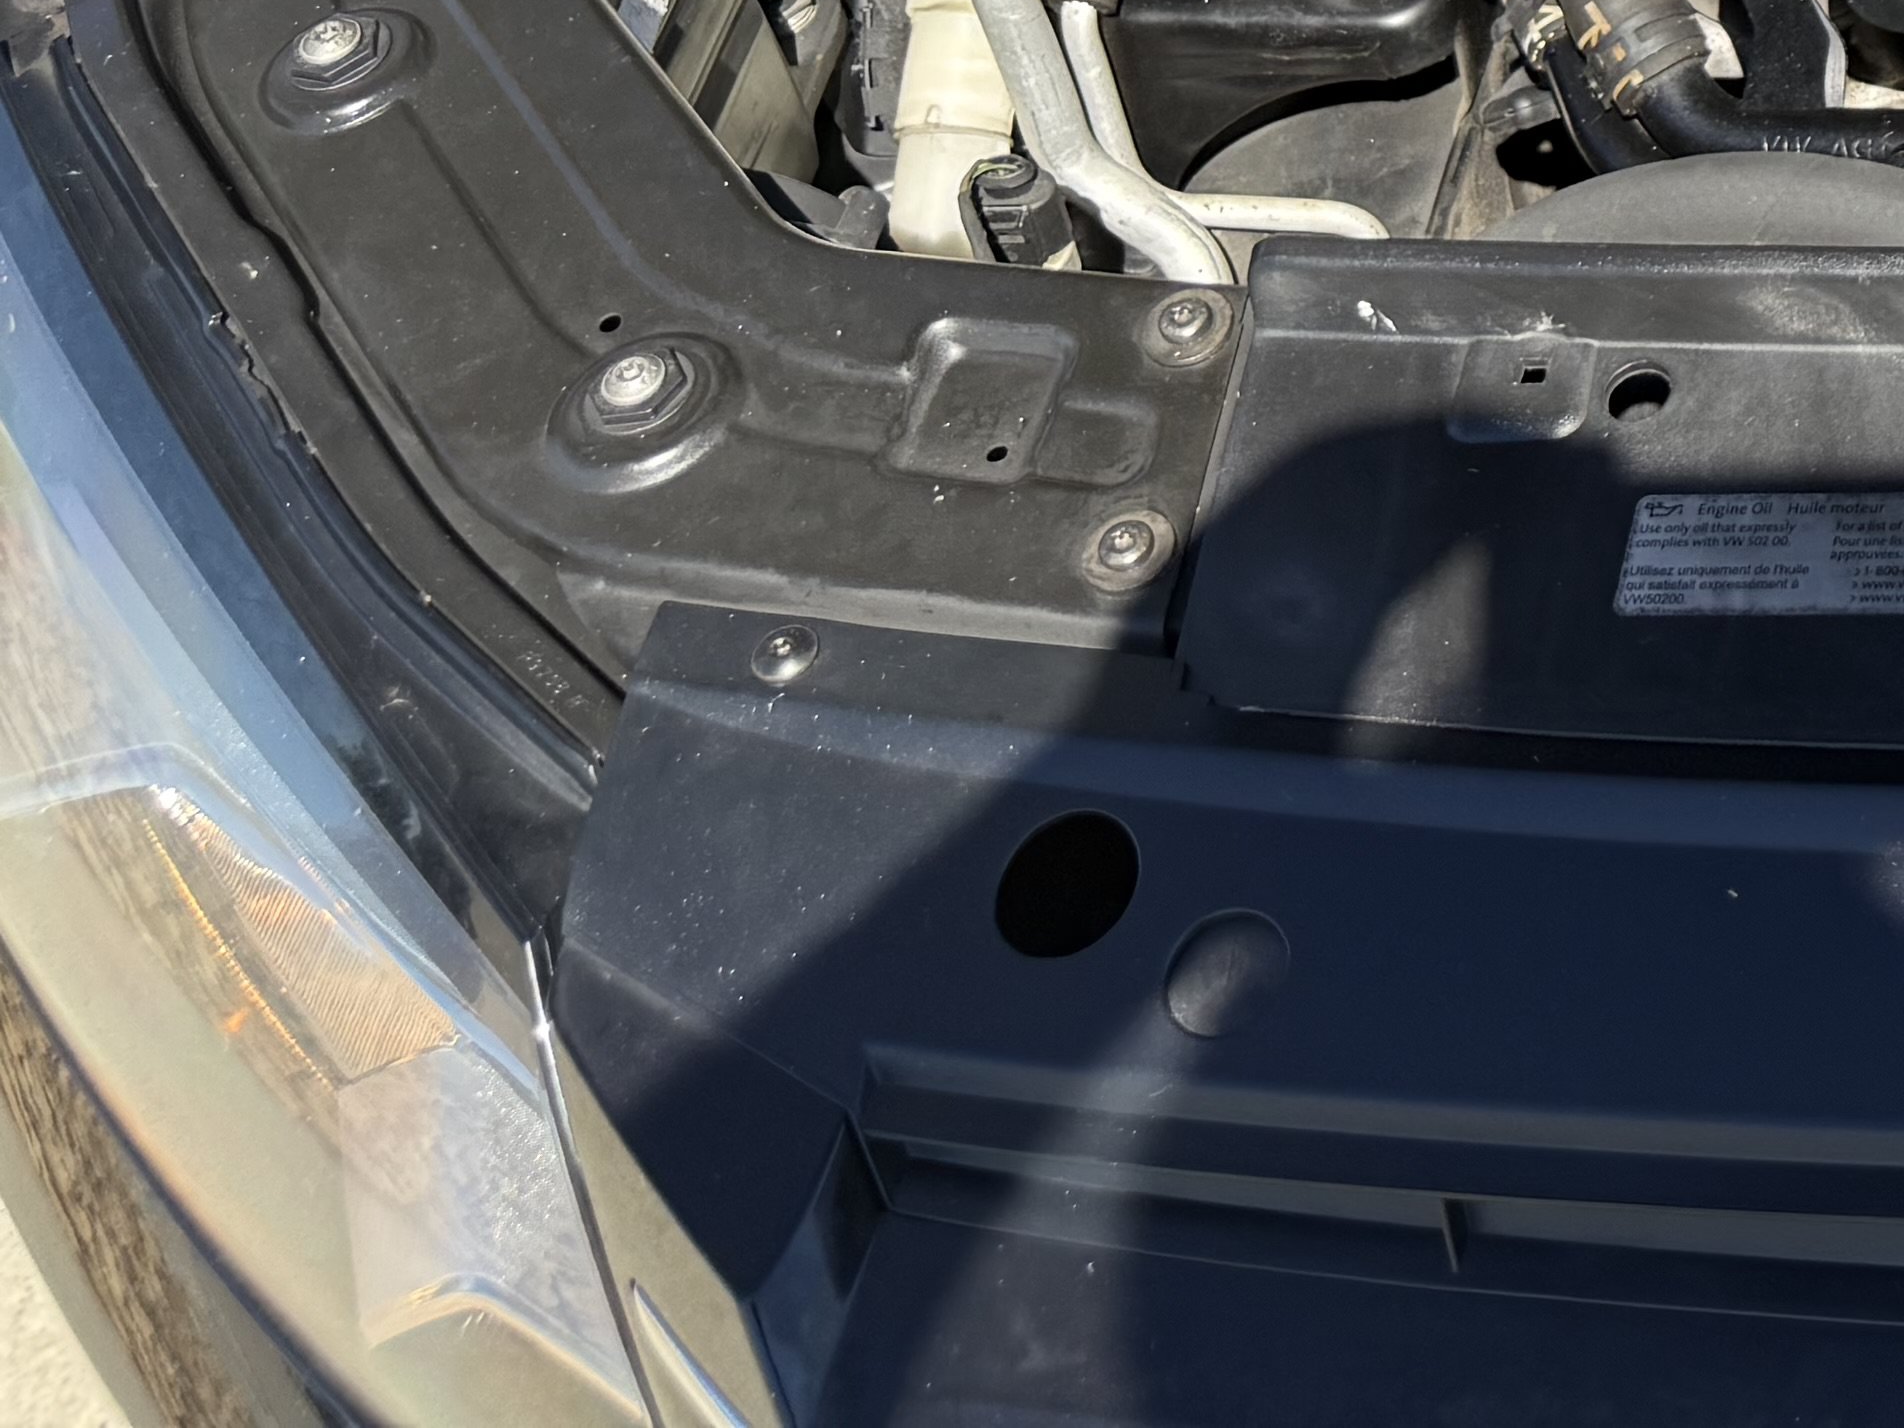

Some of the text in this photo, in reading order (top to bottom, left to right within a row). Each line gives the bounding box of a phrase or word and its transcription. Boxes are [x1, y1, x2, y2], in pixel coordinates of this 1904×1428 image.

[1698, 501, 1885, 519] Engine Oil Huile moteur
[1640, 524, 1662, 534] Use
[1711, 523, 1735, 532] that
[1739, 520, 1796, 535] expressly
[1636, 537, 1689, 550] complies
[1723, 536, 1744, 546] VW
[1678, 564, 1751, 579] uniquement
